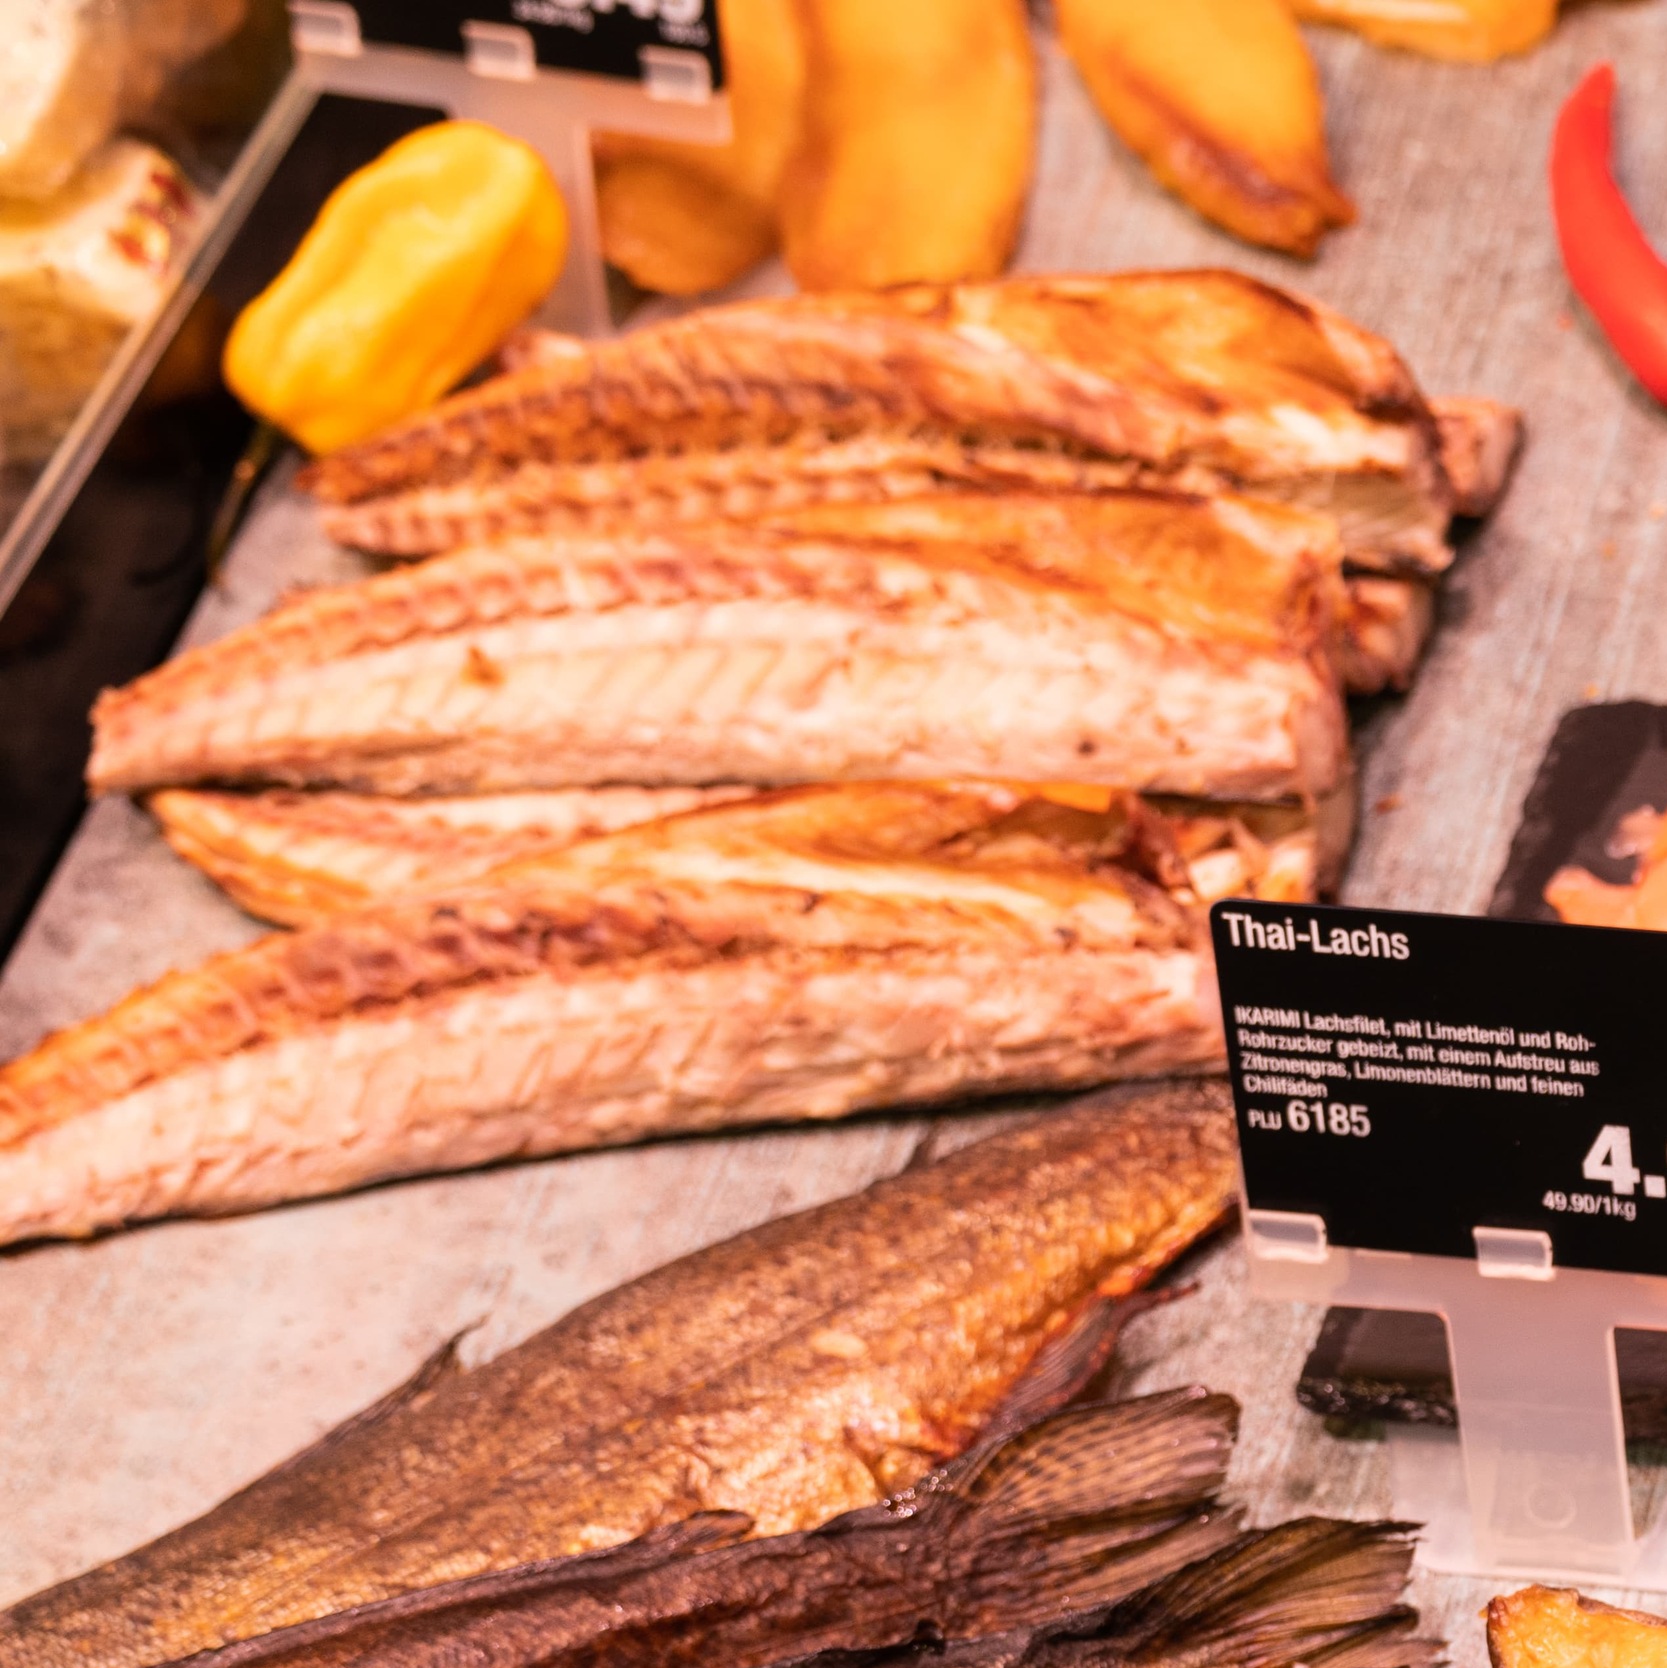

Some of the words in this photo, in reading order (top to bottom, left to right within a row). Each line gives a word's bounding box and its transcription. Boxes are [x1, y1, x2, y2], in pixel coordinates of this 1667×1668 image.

[1222, 911, 1410, 960] Thai-Lachs
[1234, 1005, 1301, 1029] IKARIMI
[1303, 1011, 1391, 1038] Lachsfilet,
[1394, 1019, 1422, 1039] mit
[1425, 1021, 1515, 1046] Limettenöl
[1519, 1031, 1551, 1049] und
[1555, 1031, 1596, 1052] Roh-
[1237, 1028, 1333, 1054] Rohrzucker
[1336, 1038, 1404, 1062] gebeizt,
[1406, 1044, 1435, 1062] mit
[1438, 1046, 1491, 1067] einem
[1494, 1050, 1566, 1073] Aufstreu
[1569, 1059, 1600, 1077] aus
[1240, 1051, 1352, 1080] Zitronengras,
[1353, 1060, 1491, 1090] Limonenblättern
[1495, 1075, 1527, 1092] und
[1530, 1075, 1585, 1098] feinen
[1243, 1074, 1328, 1098] Chilifäden
[1248, 1109, 1282, 1131] PLU
[1287, 1099, 1372, 1138] 6185
[1542, 1189, 1637, 1222] 49.90/1kg
